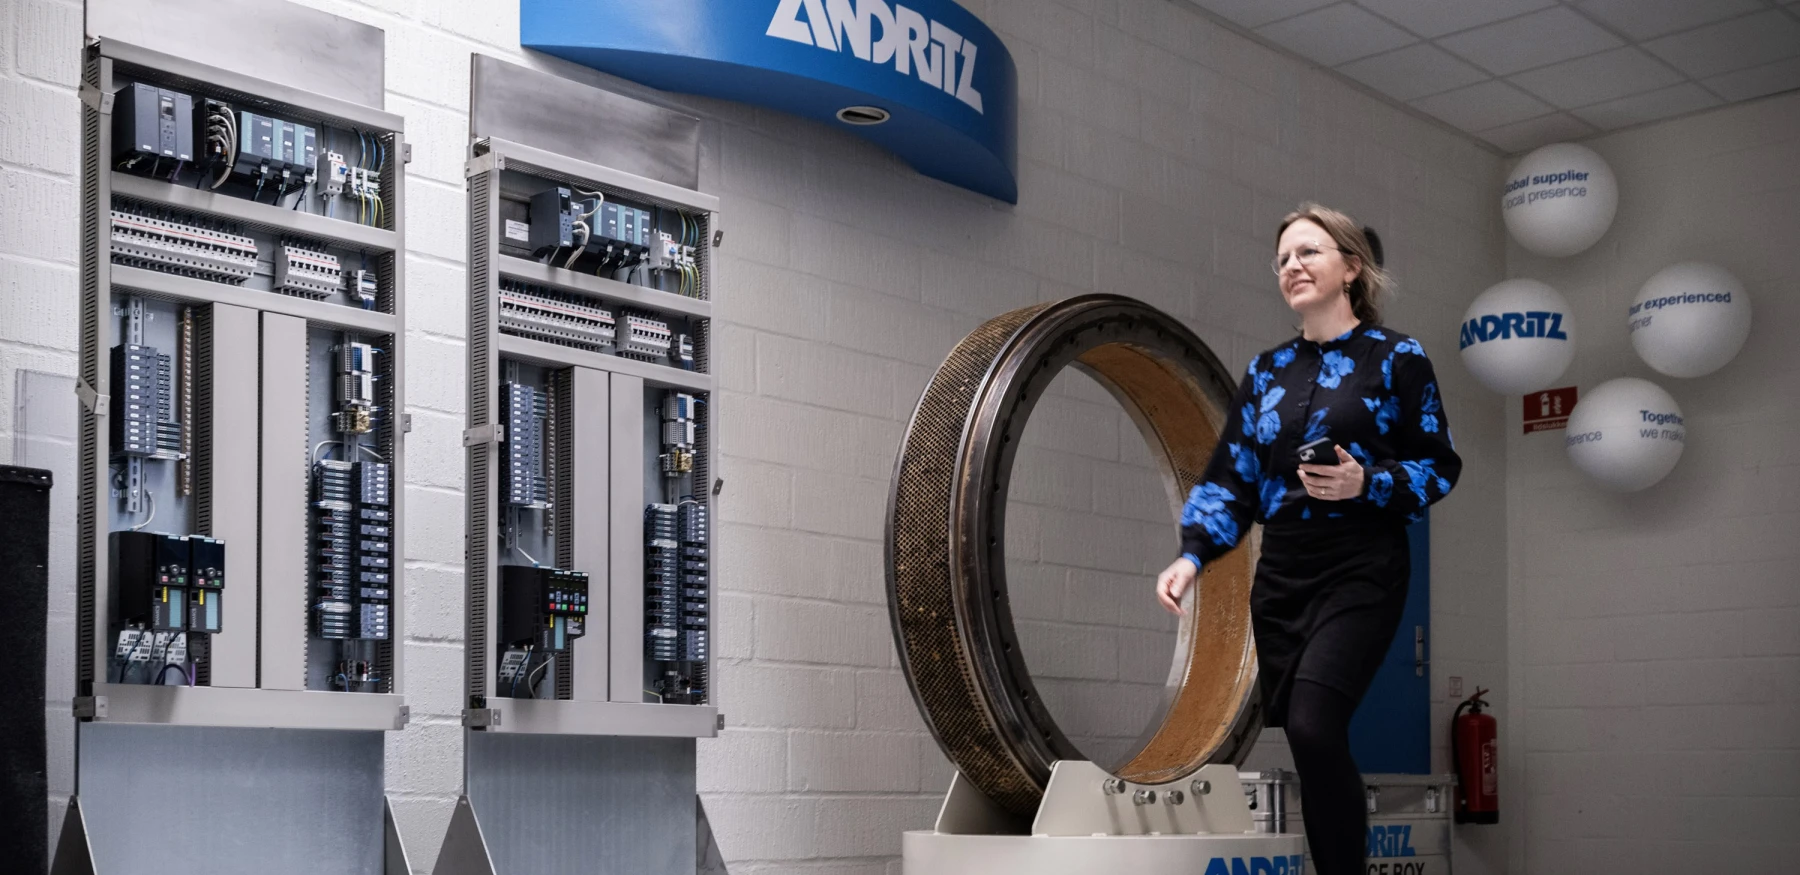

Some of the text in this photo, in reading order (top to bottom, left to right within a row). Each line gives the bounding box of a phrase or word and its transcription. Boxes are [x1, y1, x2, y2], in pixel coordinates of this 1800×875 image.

[1532, 169, 1589, 185] supplier
[1528, 186, 1587, 204] presence
[1644, 292, 1731, 310] experienced
[1459, 311, 1567, 351] ANDRITZ
[1640, 427, 1658, 439] we
